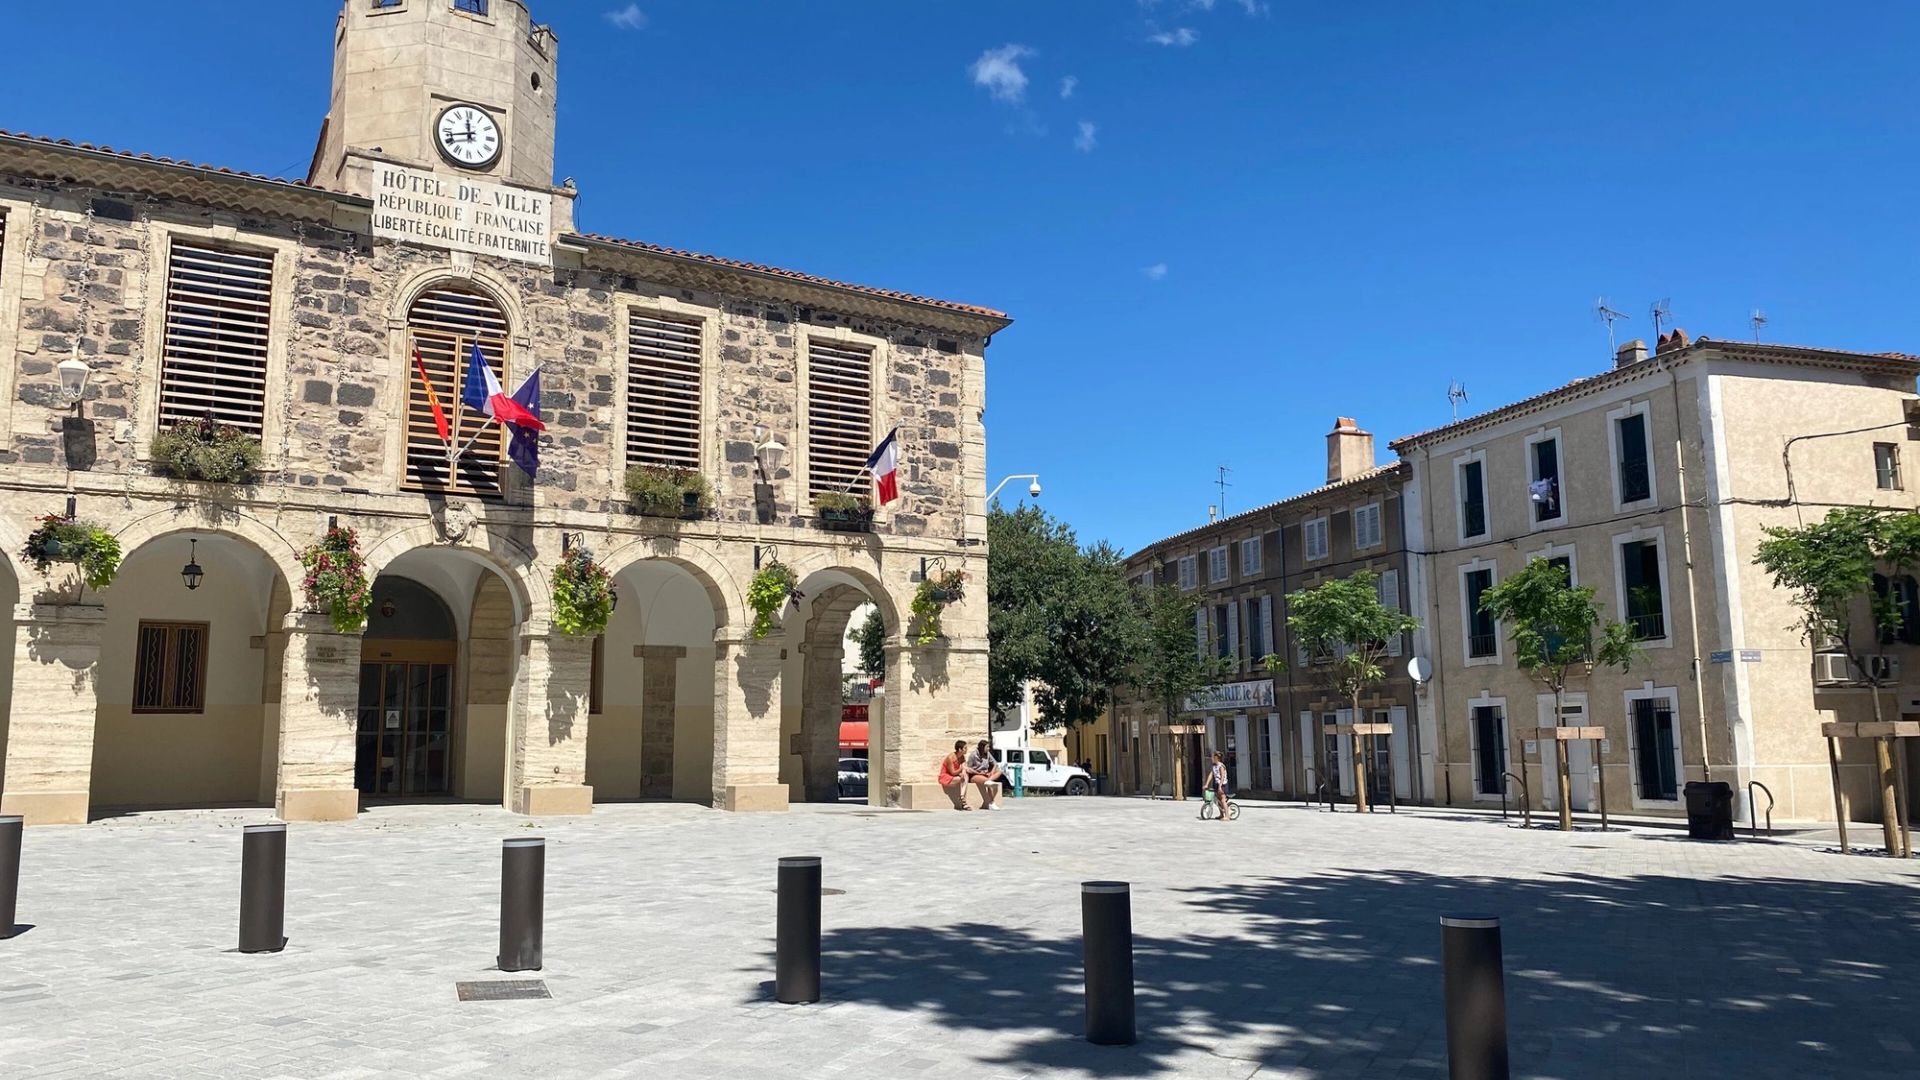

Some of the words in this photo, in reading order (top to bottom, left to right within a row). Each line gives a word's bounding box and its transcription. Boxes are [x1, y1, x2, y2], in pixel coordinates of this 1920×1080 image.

[379, 191, 462, 221] RÉPUBLIQUE
[474, 210, 544, 236] FRANÇAISE
[383, 168, 446, 198] HÔTEL
[458, 185, 481, 204] DE
[494, 191, 542, 216] VILLE
